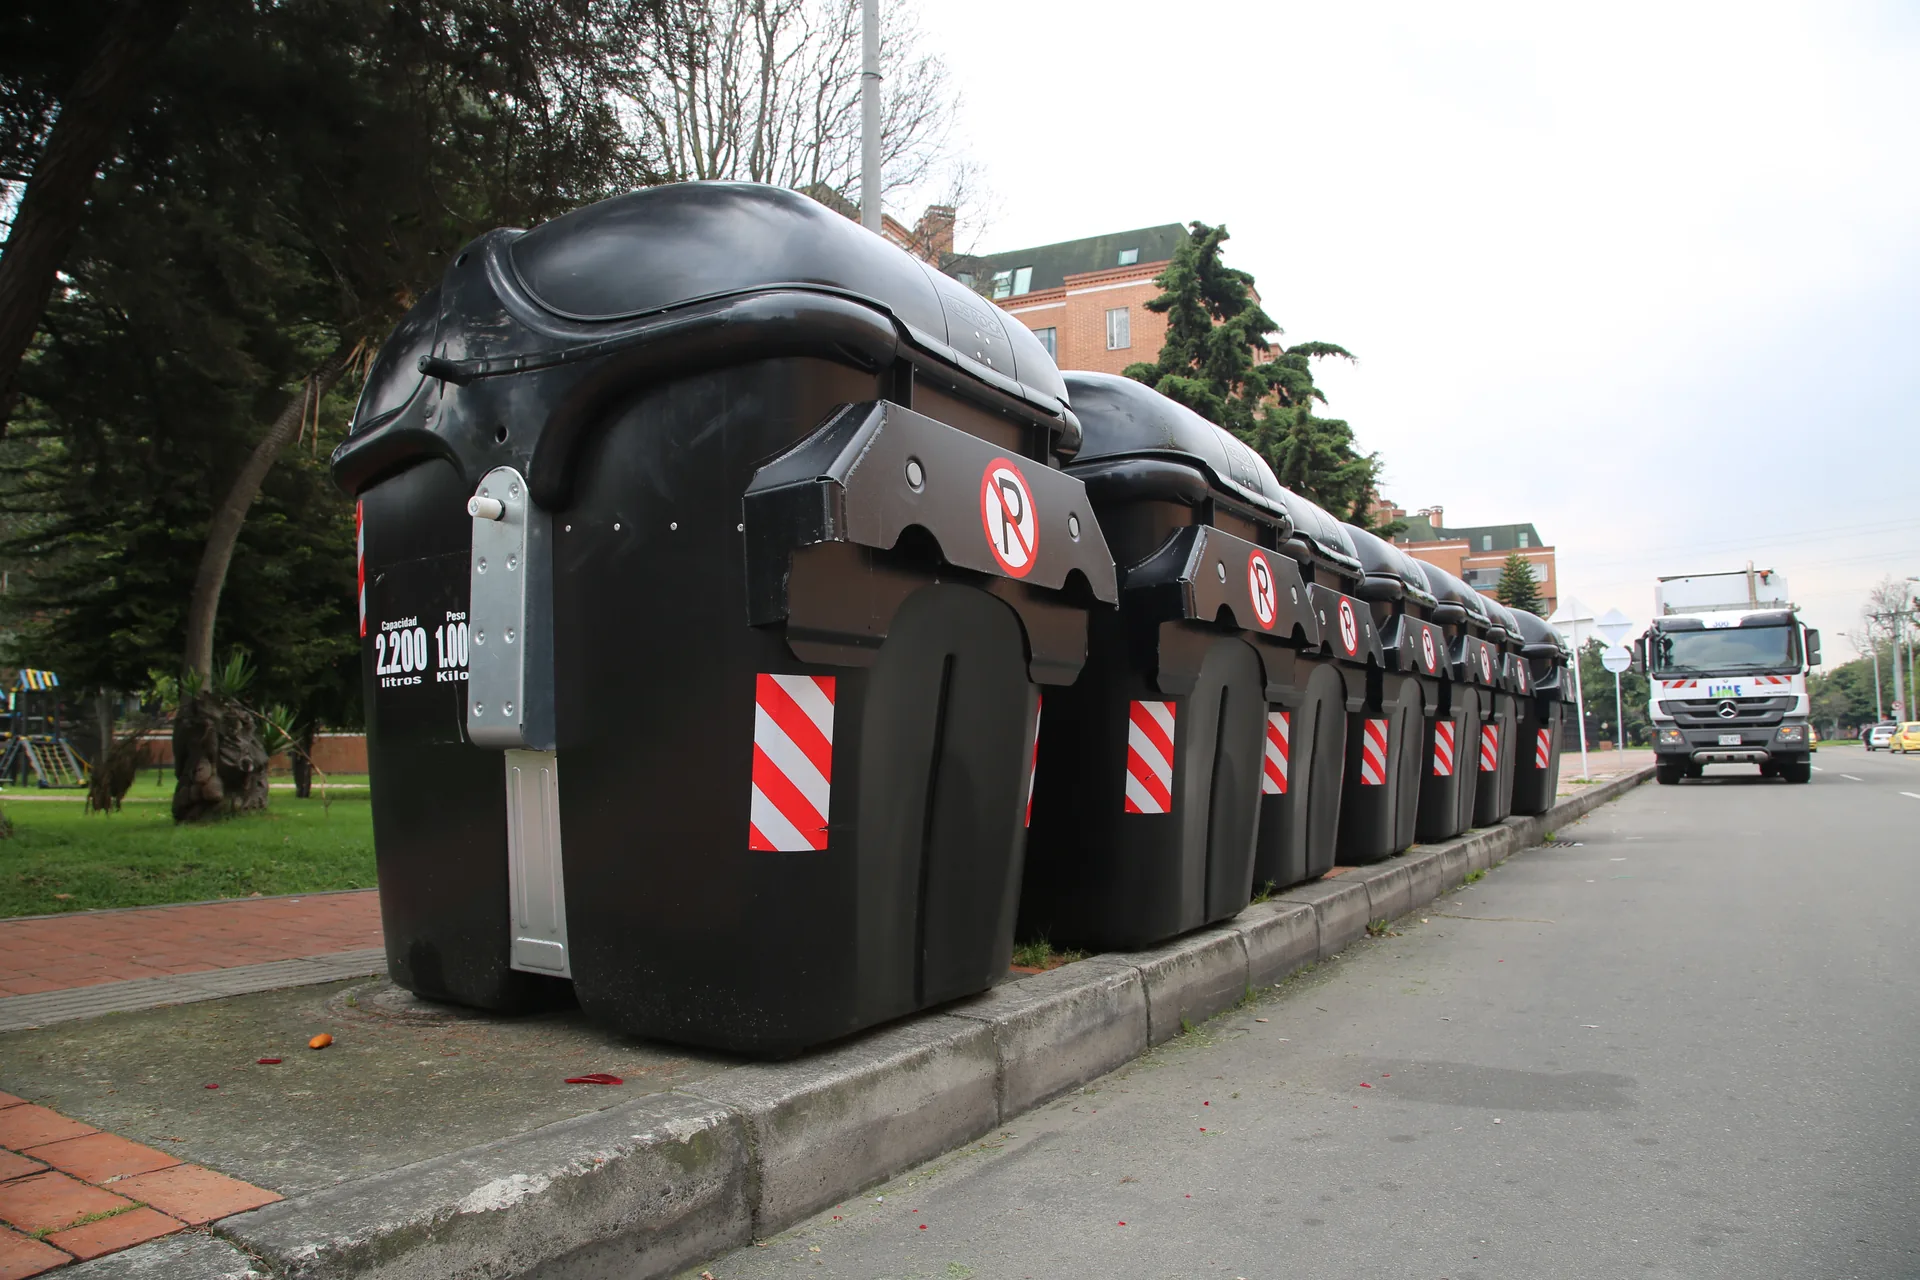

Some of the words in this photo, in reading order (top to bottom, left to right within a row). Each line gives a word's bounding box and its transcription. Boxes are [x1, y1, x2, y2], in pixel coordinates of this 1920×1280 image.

[999, 476, 1024, 555] P
[1255, 563, 1268, 615] P
[381, 616, 417, 632] Capacidad
[446, 611, 466, 622] Peso
[375, 627, 428, 676] 2.200
[435, 622, 470, 668] 1.00
[381, 675, 422, 688] litros
[1708, 684, 1742, 697] LIME
